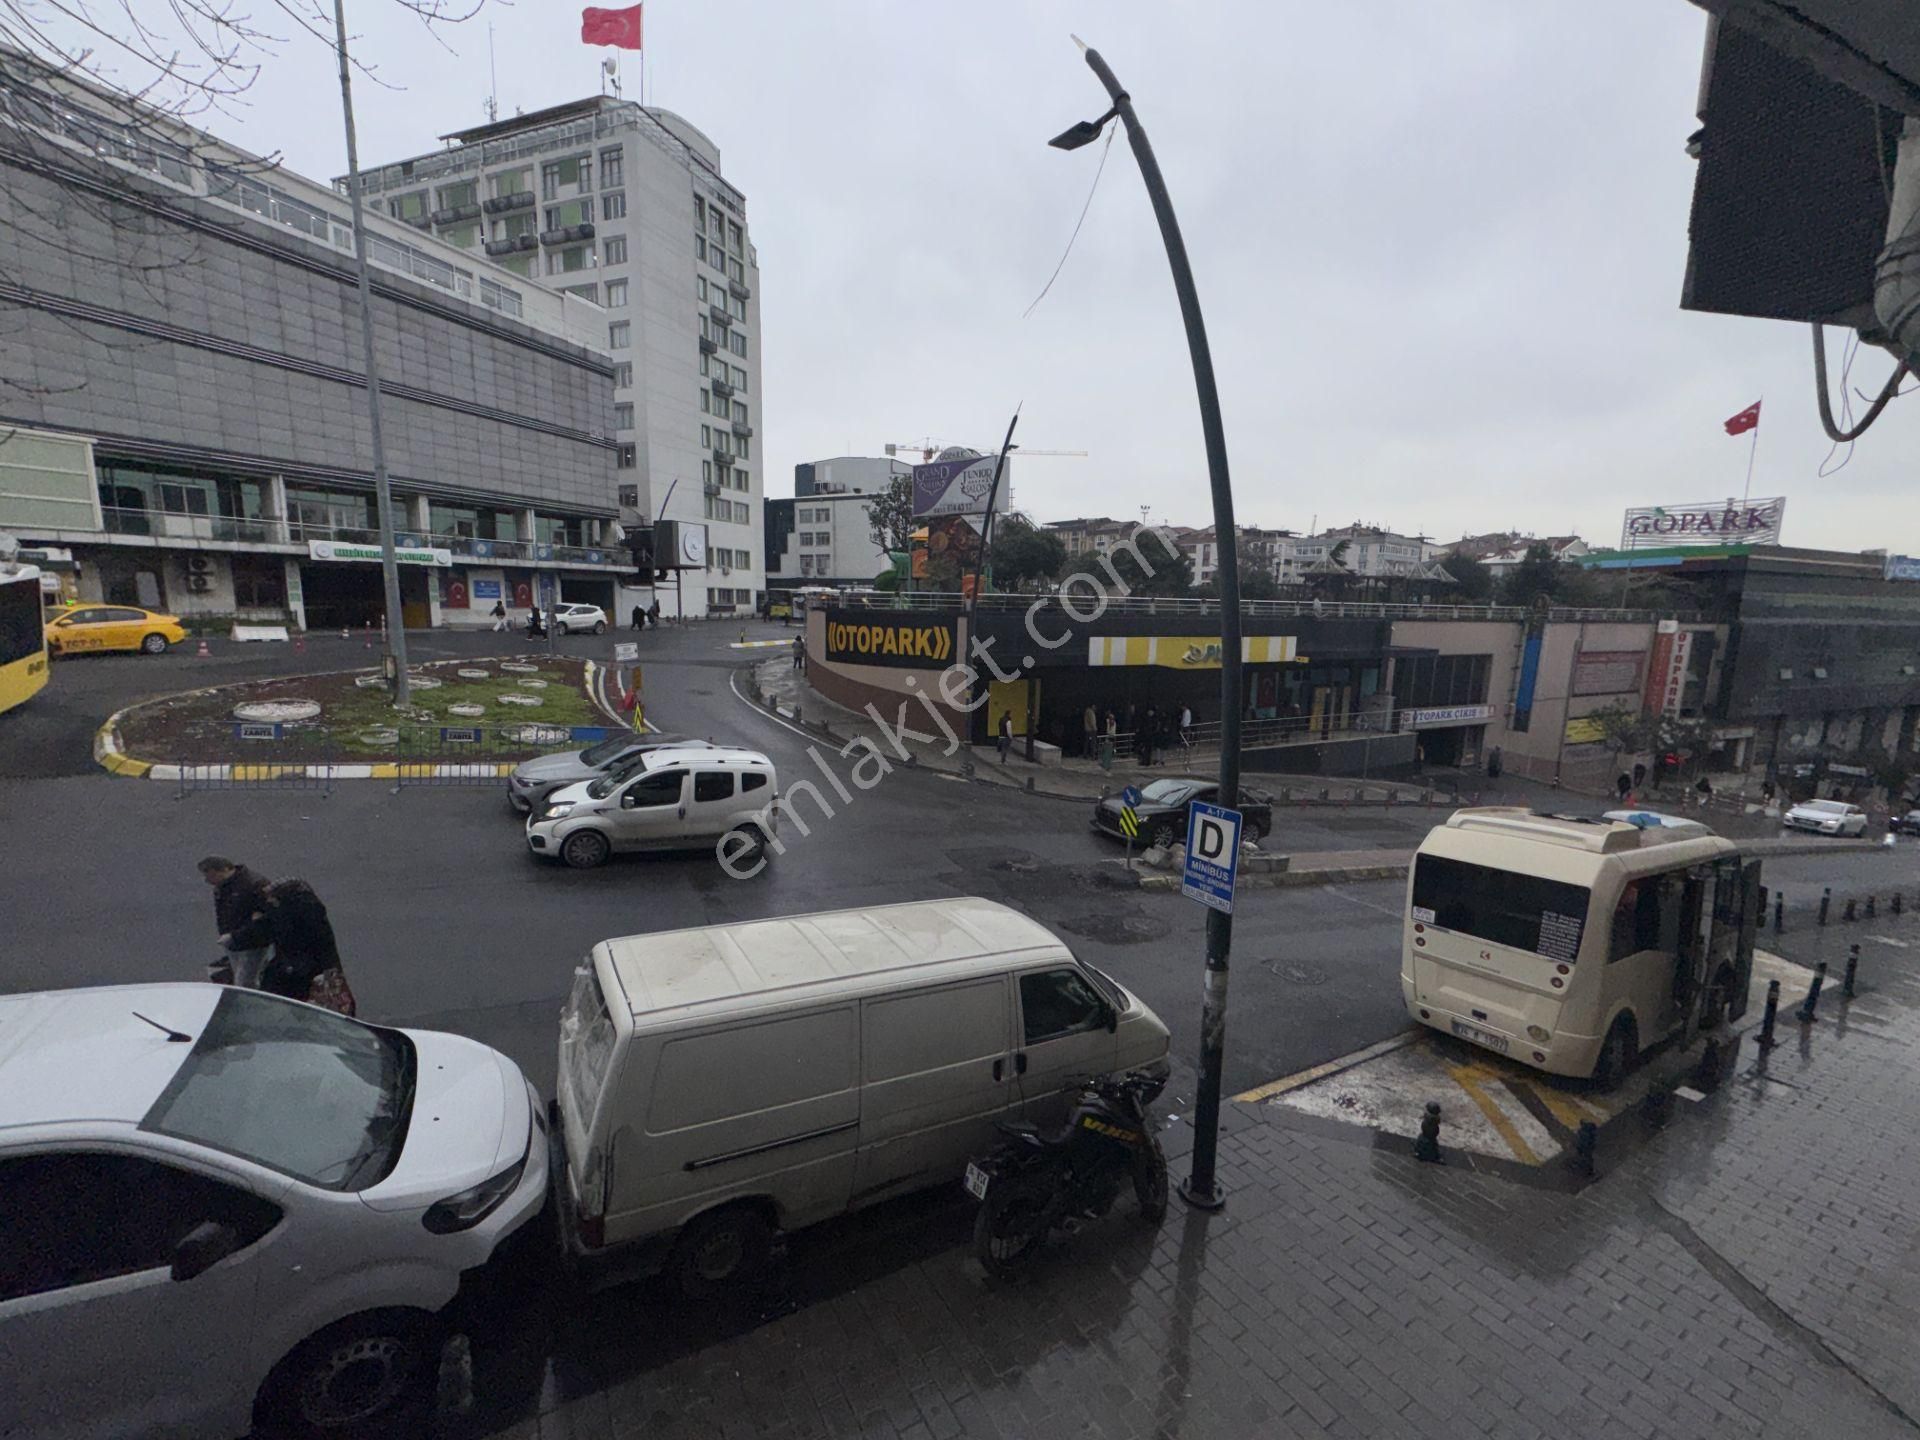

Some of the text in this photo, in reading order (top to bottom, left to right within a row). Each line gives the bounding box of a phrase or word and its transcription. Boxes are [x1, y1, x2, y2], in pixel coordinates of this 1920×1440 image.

[963, 468, 993, 484] JUNIOR
[836, 624, 933, 657] OTOPARK
[1668, 632, 1687, 707] OTOPARK
[1206, 808, 1225, 818] A-17
[1199, 819, 1224, 859] D
